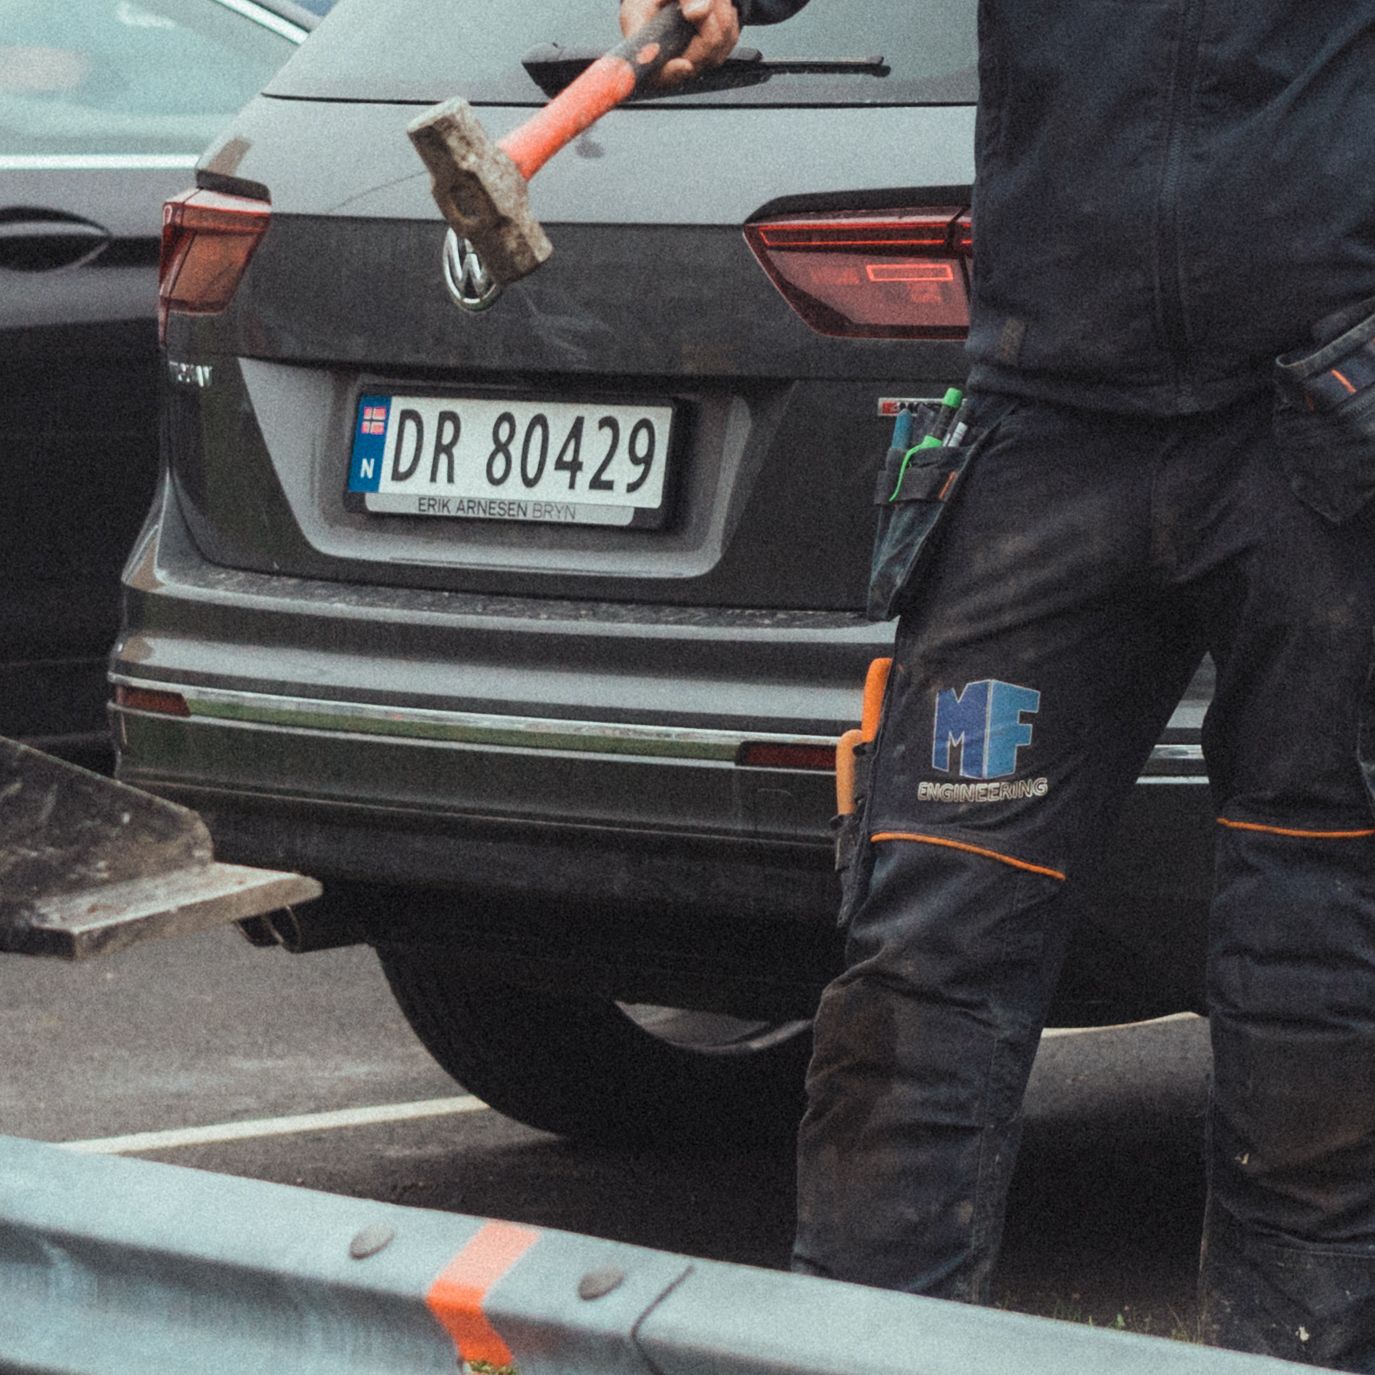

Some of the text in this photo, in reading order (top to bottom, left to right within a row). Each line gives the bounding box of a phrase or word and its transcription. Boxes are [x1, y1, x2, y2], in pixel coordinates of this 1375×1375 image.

[389, 408, 657, 494] DR 80429
[359, 458, 375, 479] N
[417, 497, 577, 521] ERIK ARNESEN BRYN
[931, 678, 1042, 780] MF
[917, 776, 1049, 803] ENGINEERING
